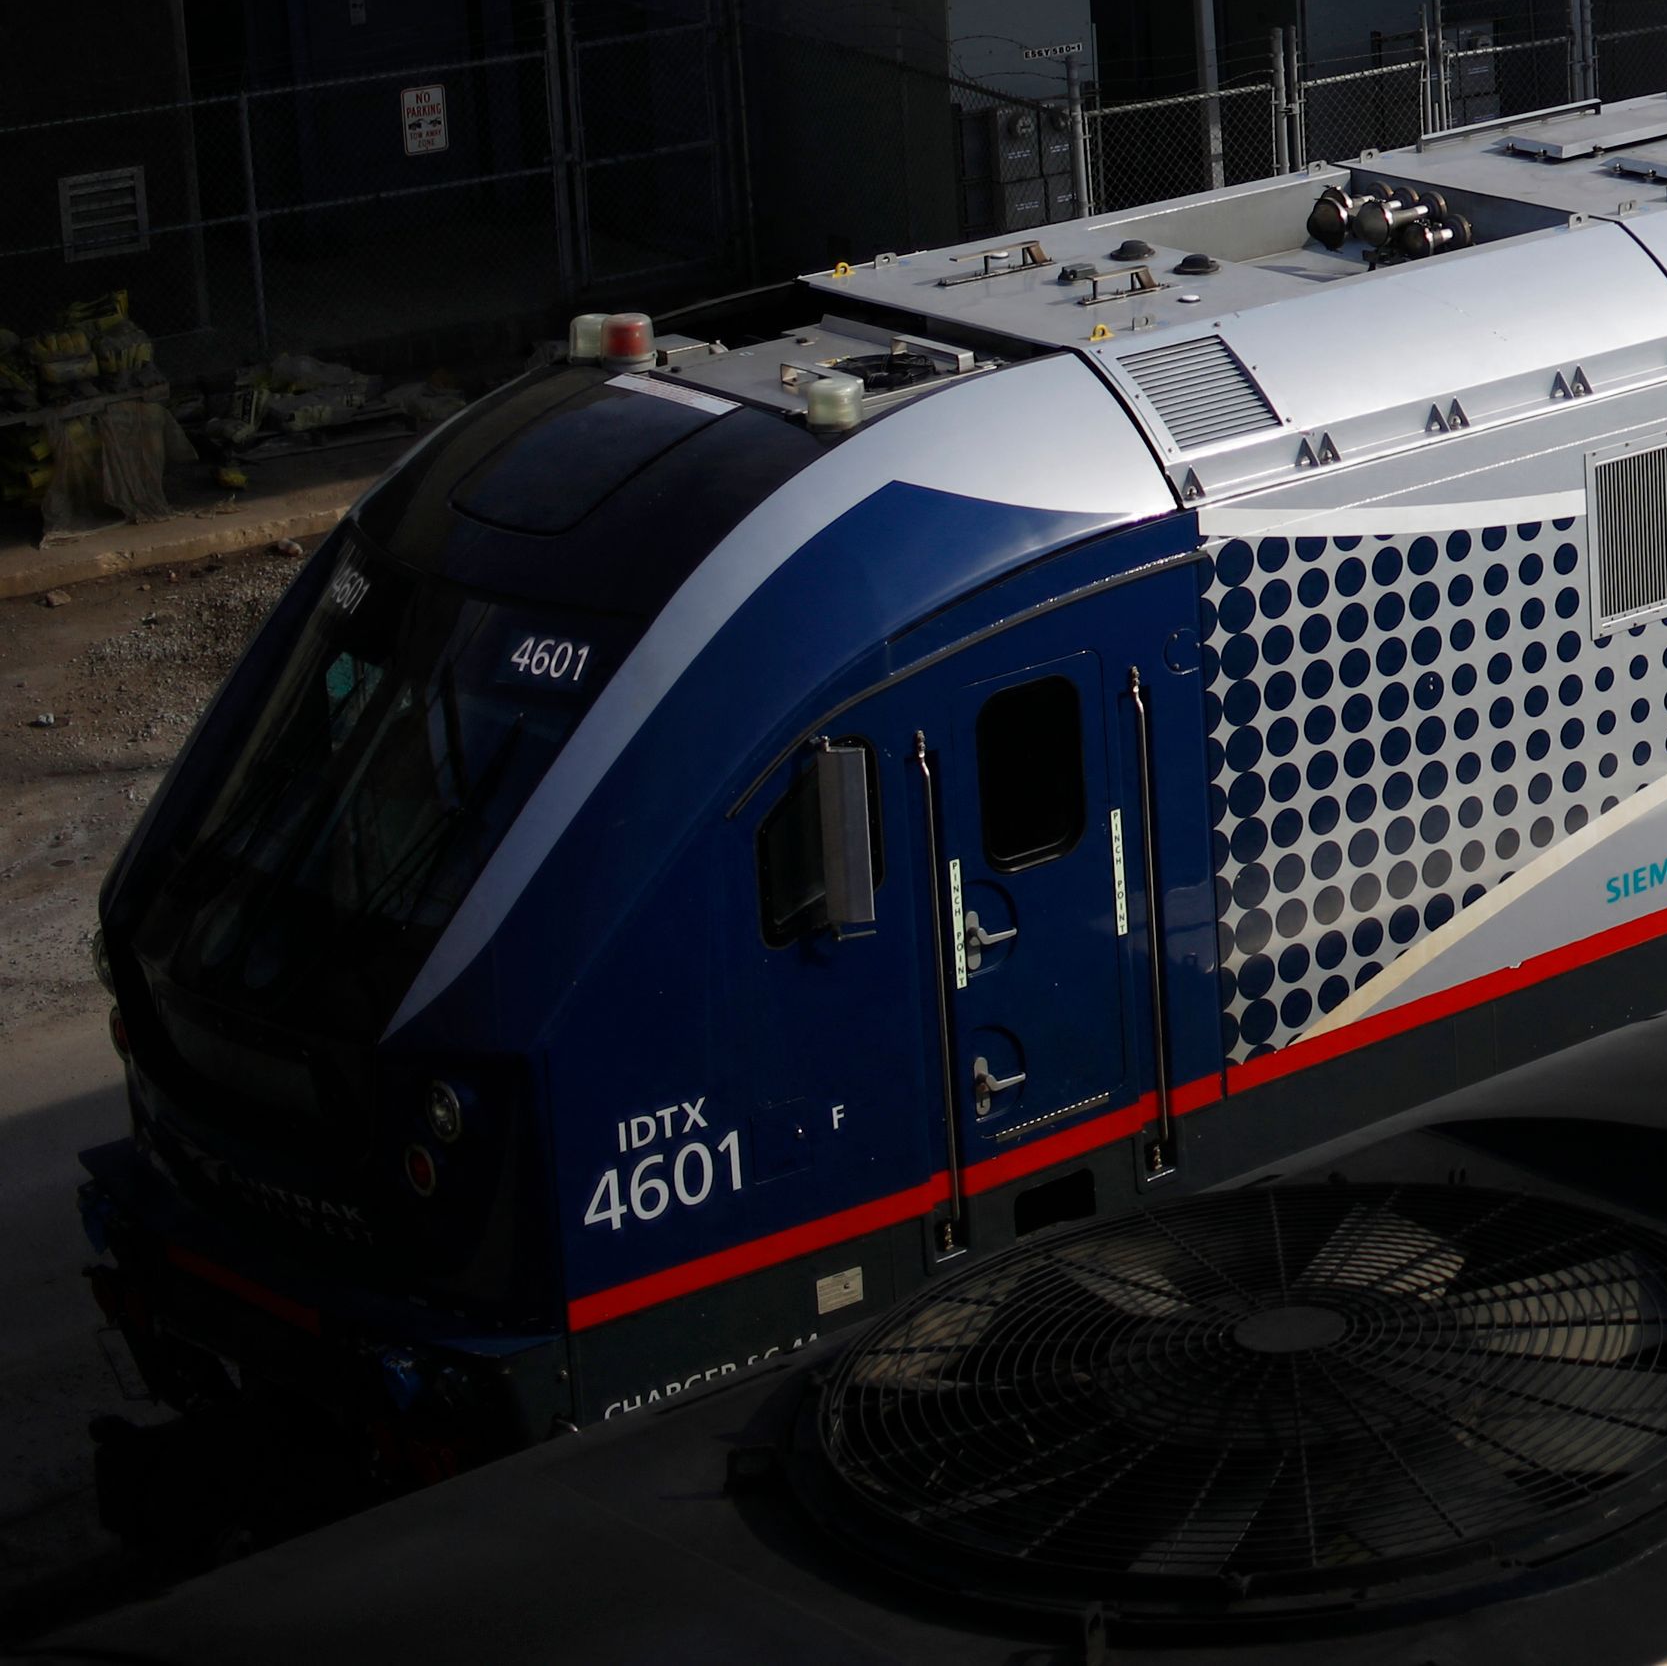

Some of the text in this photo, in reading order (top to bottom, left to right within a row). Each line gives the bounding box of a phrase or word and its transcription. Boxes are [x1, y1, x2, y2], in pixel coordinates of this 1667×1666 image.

[406, 103, 442, 118] PARKING
[416, 92, 431, 104] NO
[511, 636, 591, 682] 4601
[1113, 811, 1126, 934] PINCH POINT
[952, 862, 965, 986] PINCH POINT
[617, 1096, 709, 1154] IDTX
[831, 1104, 845, 1131] F
[583, 1129, 743, 1231] 4601
